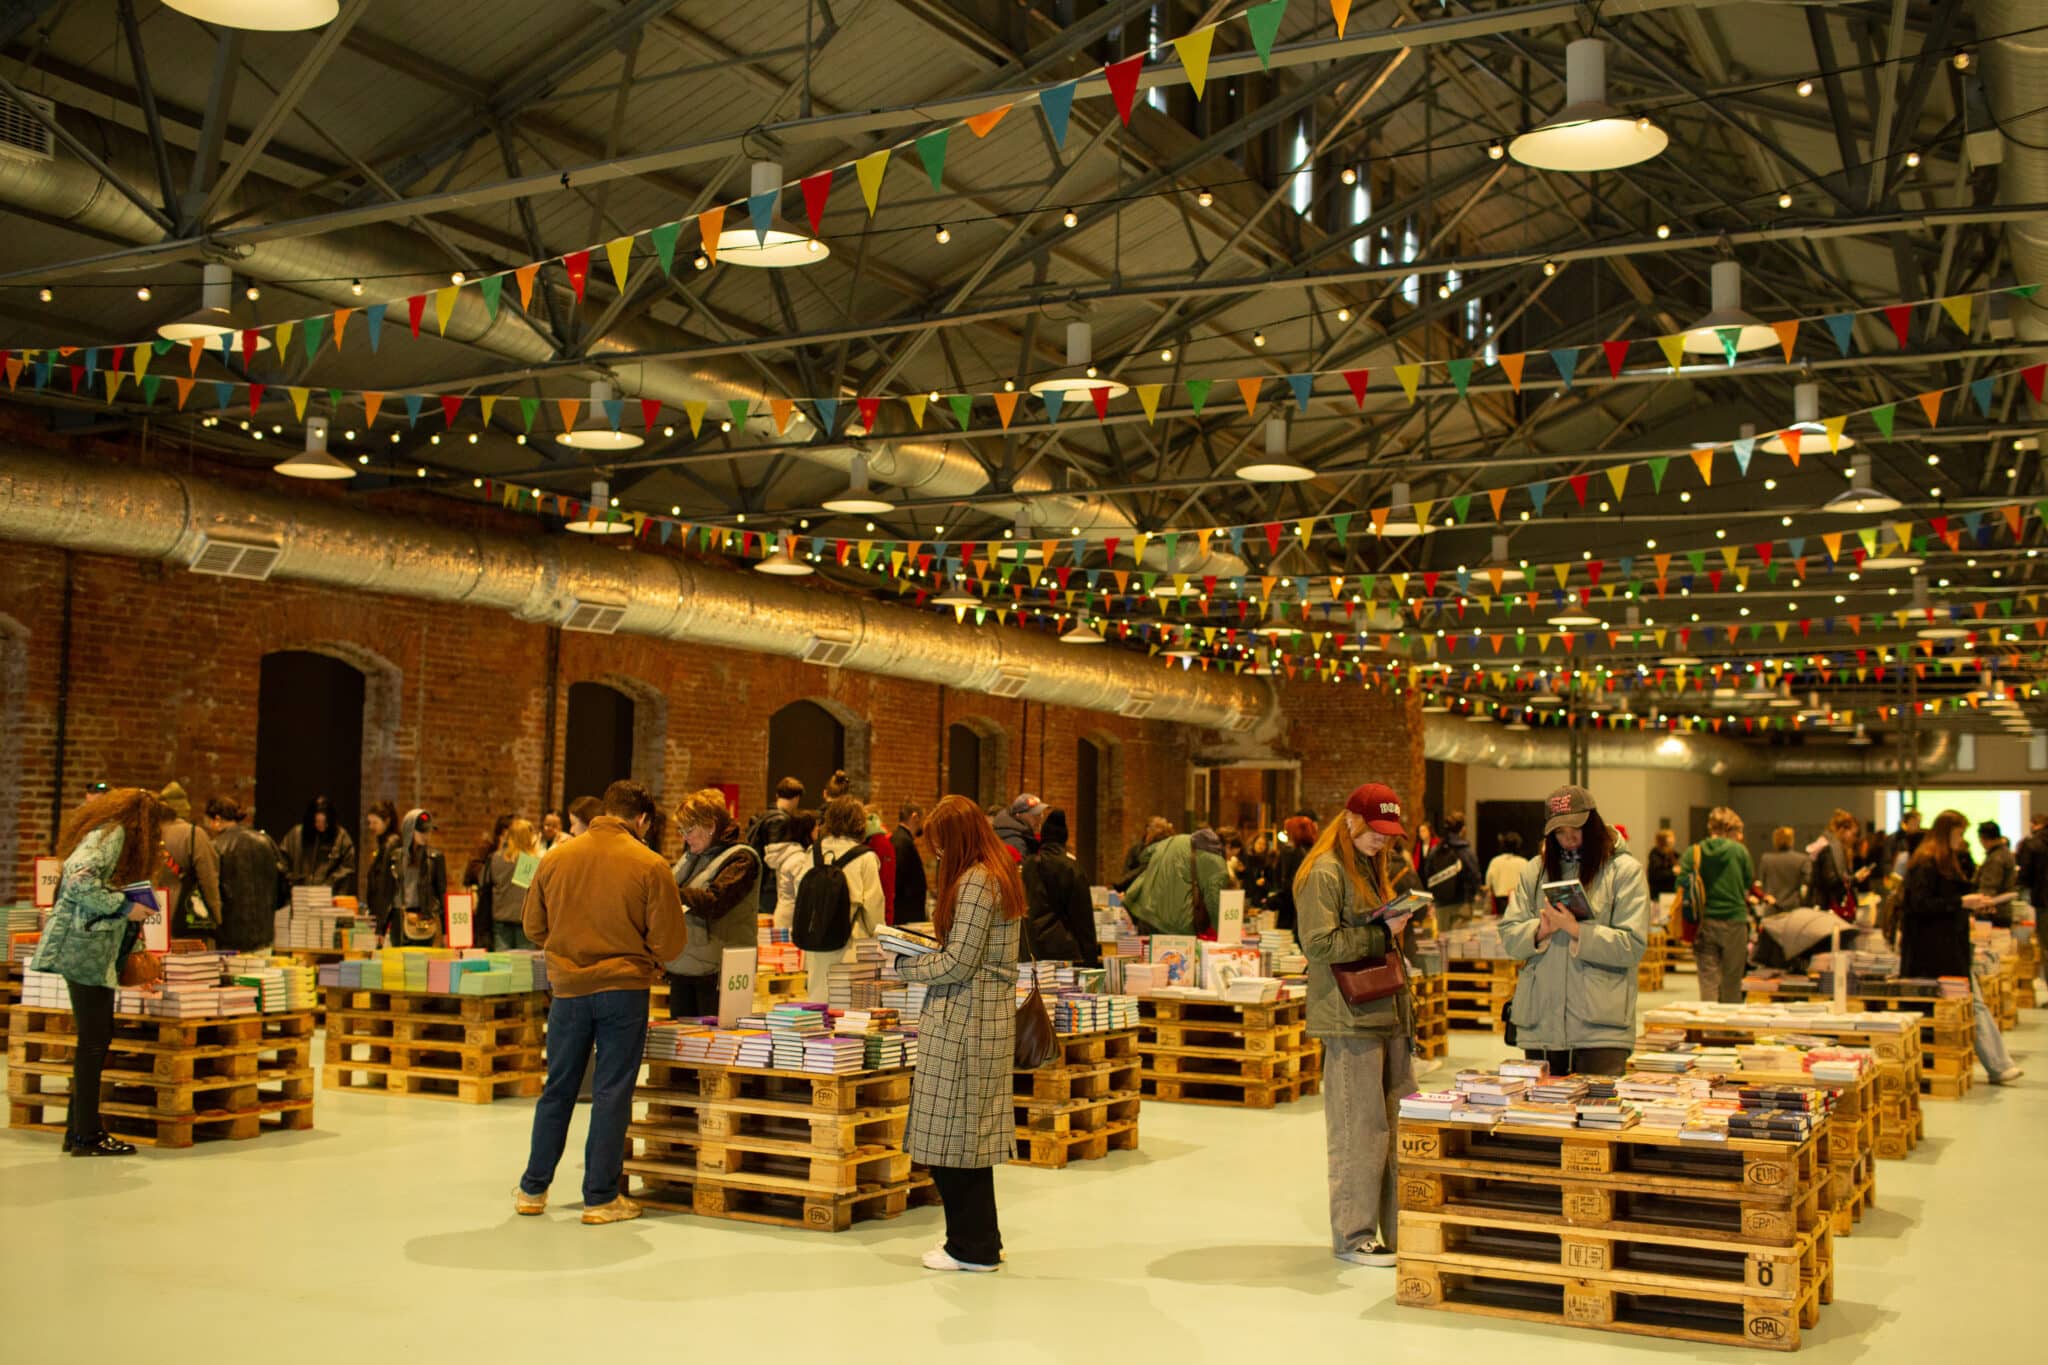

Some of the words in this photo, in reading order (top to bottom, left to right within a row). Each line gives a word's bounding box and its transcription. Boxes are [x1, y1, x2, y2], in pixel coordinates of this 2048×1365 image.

[41, 876, 58, 886] 750
[452, 912, 469, 925] 550
[1224, 909, 1239, 921] 650
[728, 974, 748, 991] 650
[1755, 1167, 1777, 1182] EUR
[1407, 1185, 1428, 1198] EPAL
[1758, 1261, 1773, 1287] Ö
[1755, 1320, 1781, 1337] EPAL
